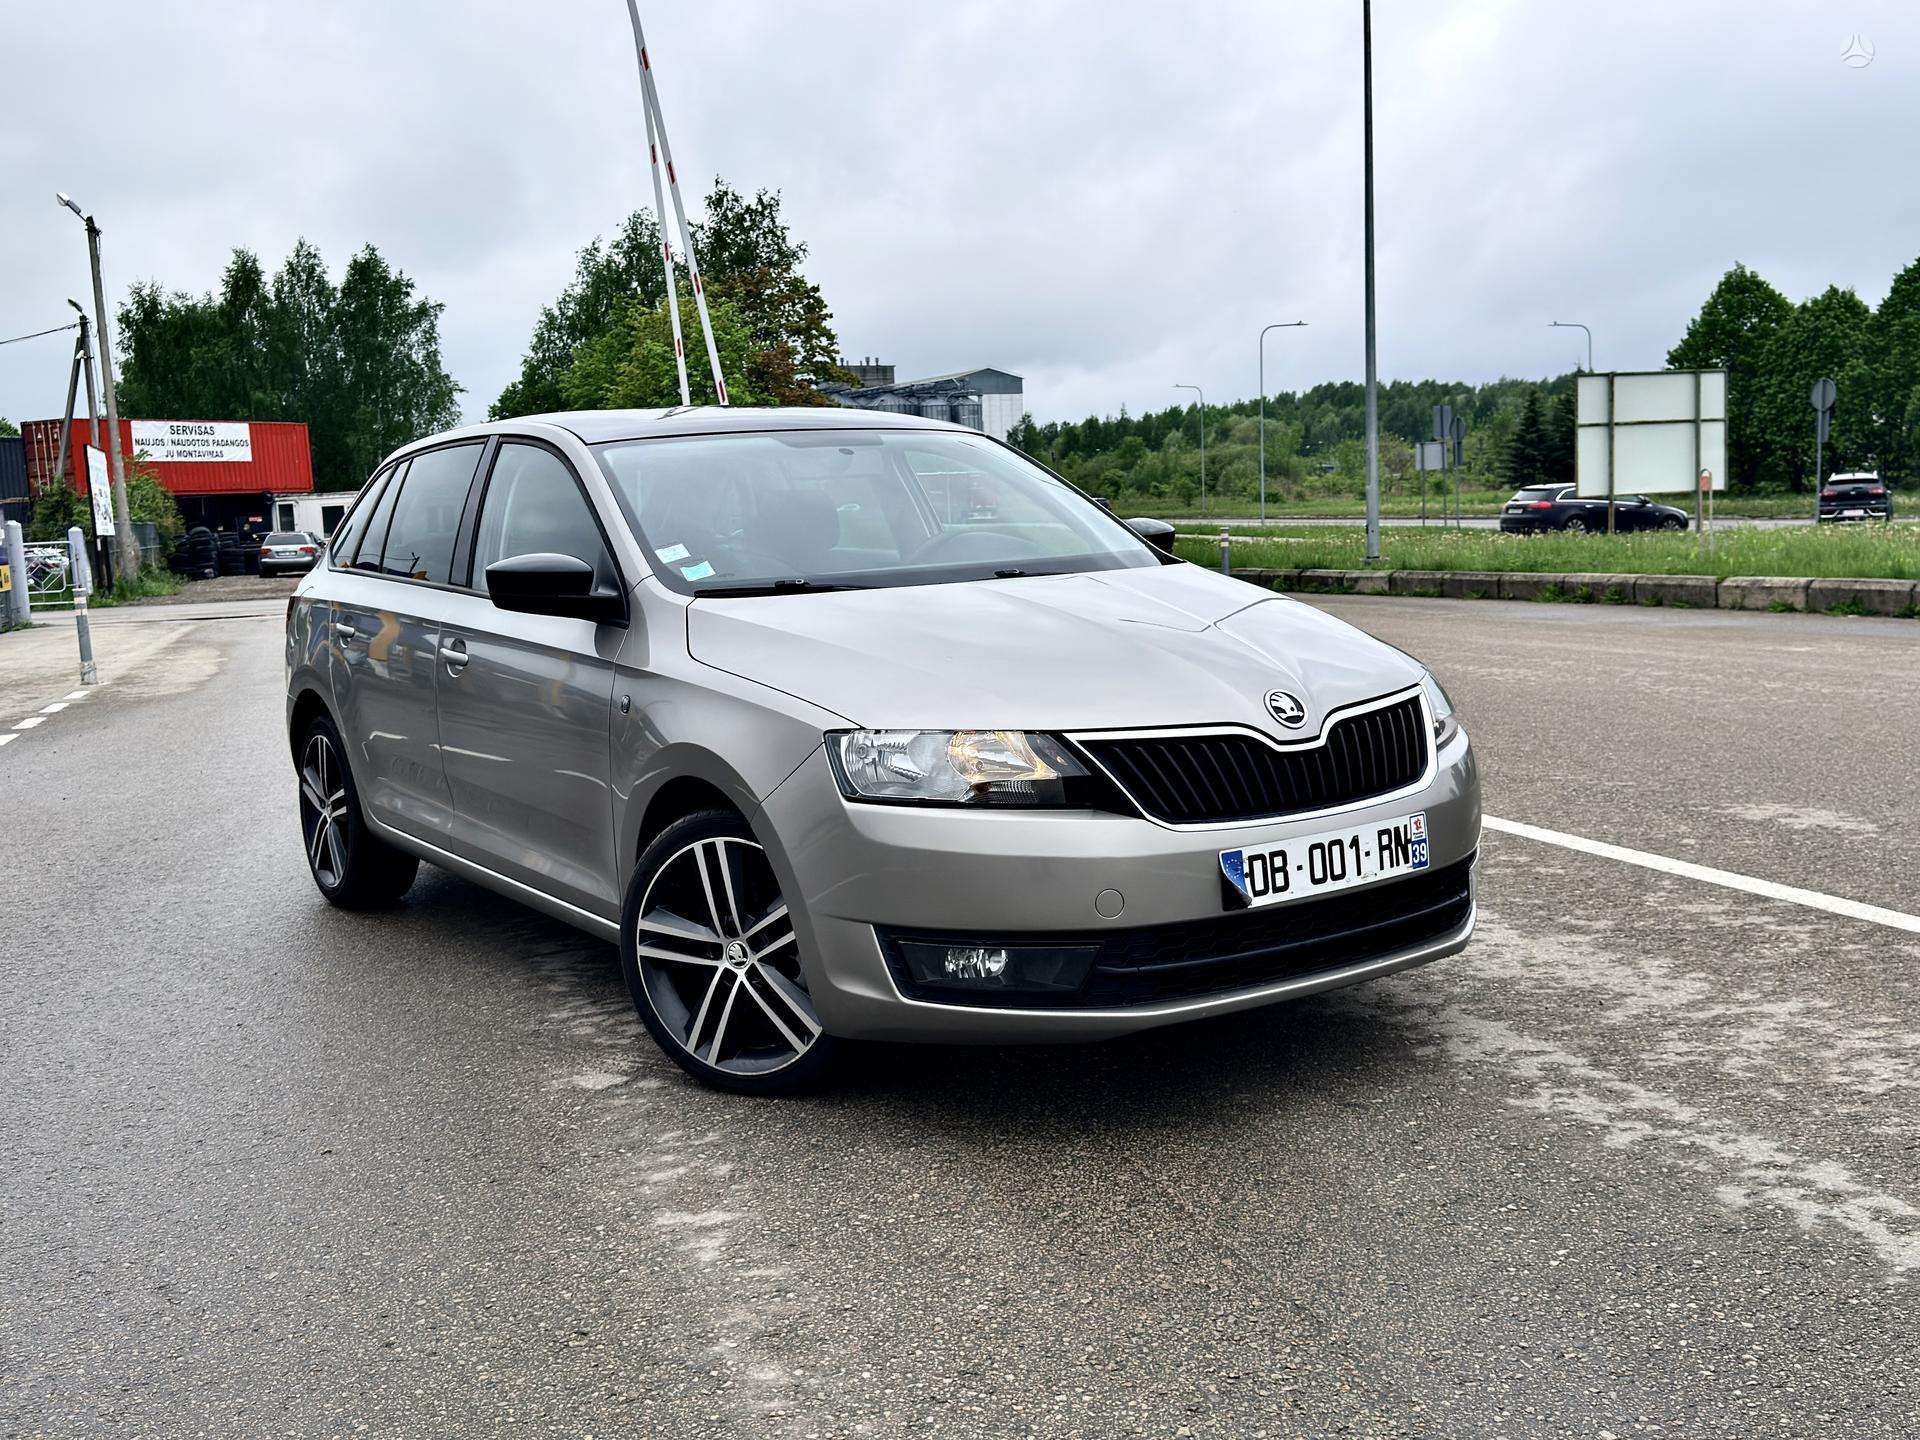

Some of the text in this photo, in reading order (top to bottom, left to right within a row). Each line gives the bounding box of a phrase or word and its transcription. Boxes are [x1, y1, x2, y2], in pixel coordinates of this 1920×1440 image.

[134, 438, 165, 447] NAUJOS
[171, 438, 211, 447] NAUDOTOS
[212, 439, 249, 448] PADANGOS
[176, 450, 224, 458] MONTAVIMAS
[1412, 843, 1427, 864] 39
